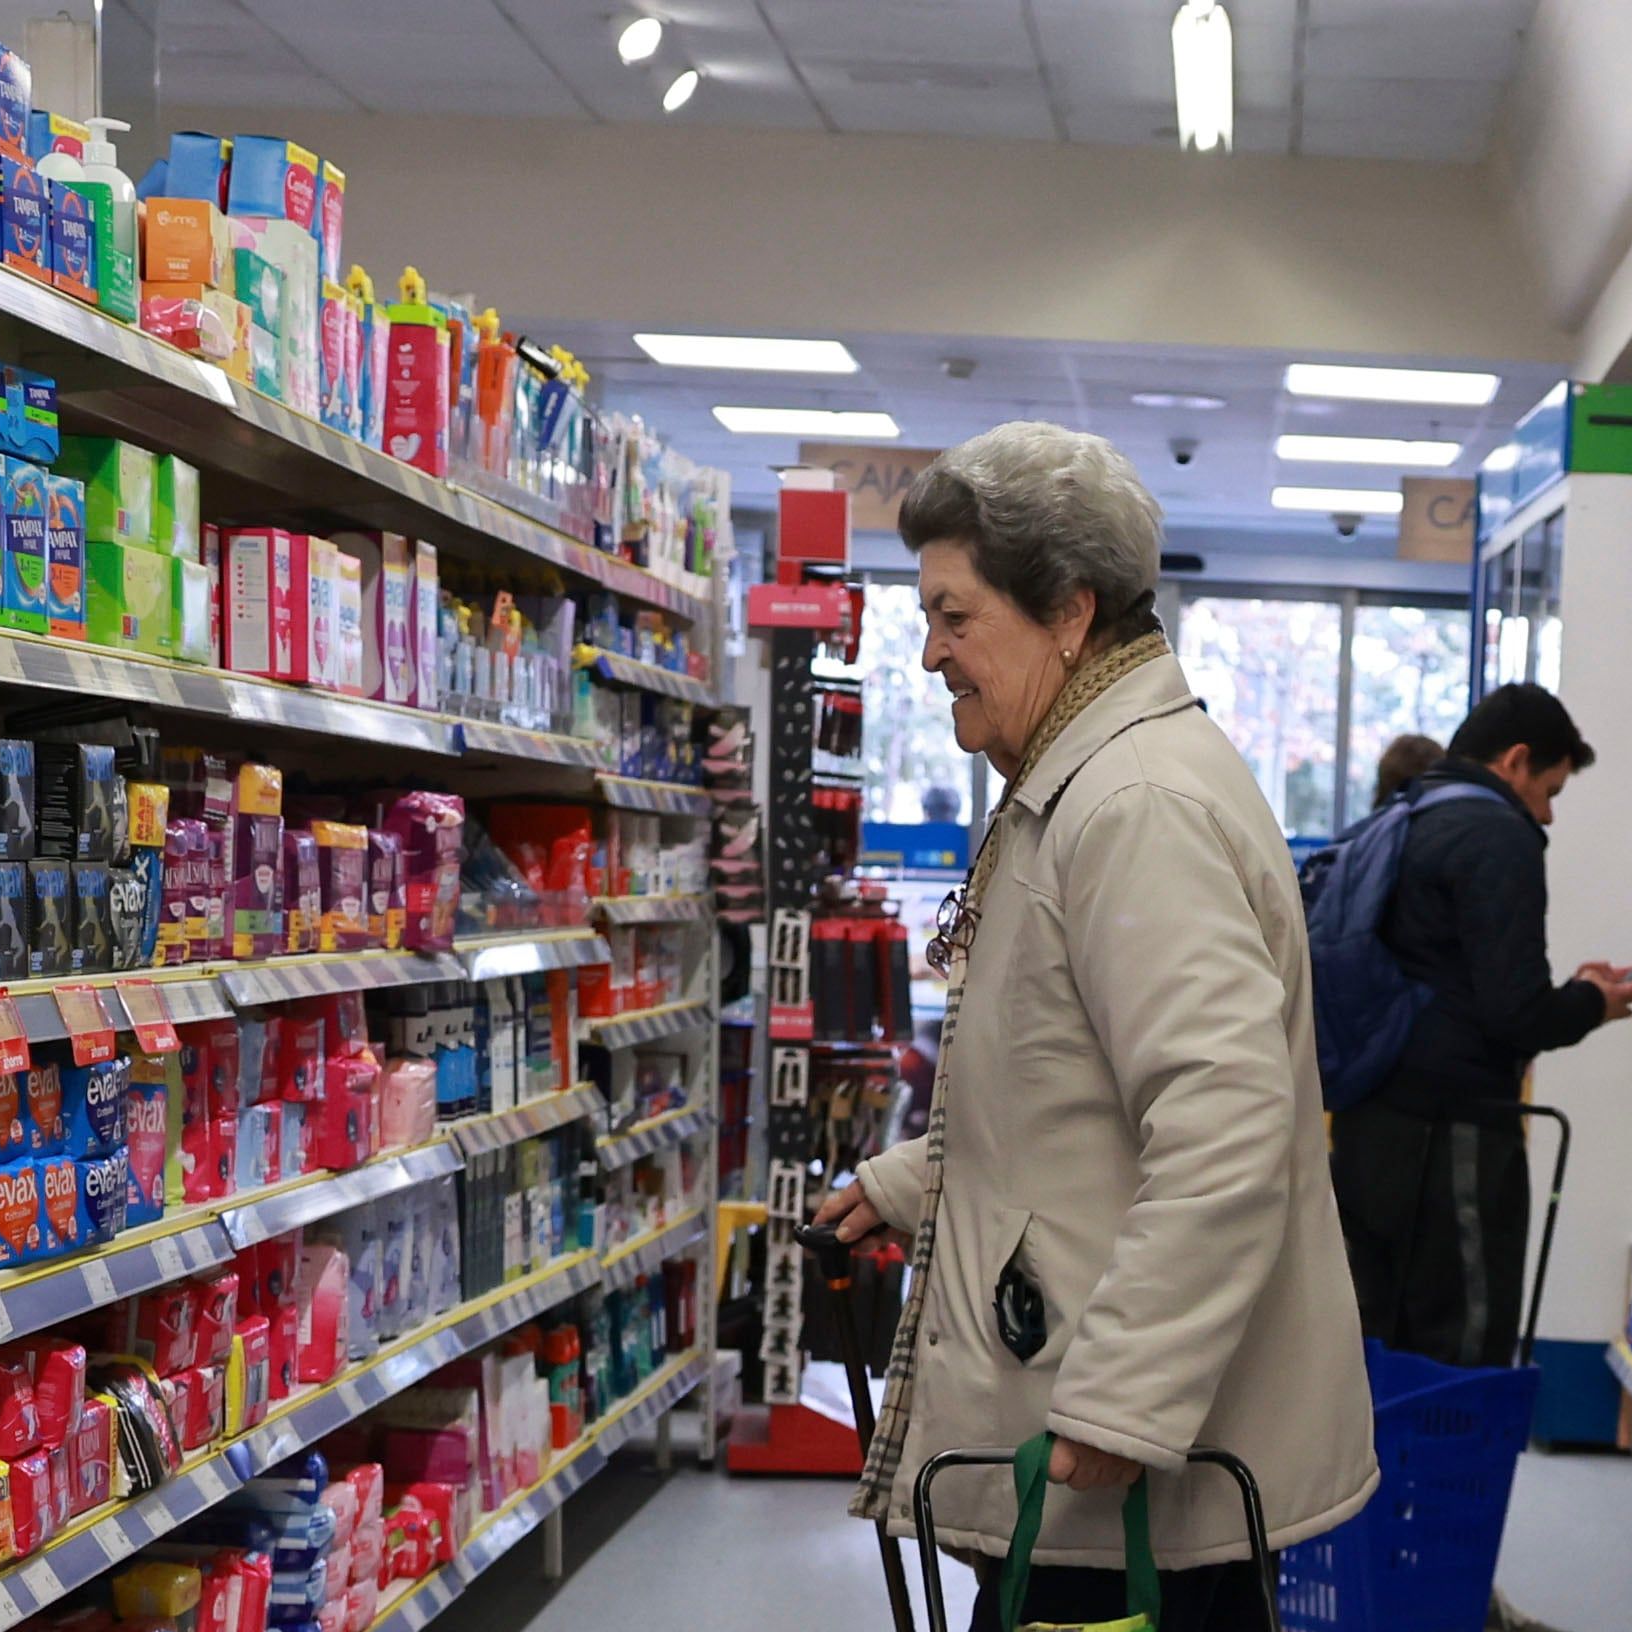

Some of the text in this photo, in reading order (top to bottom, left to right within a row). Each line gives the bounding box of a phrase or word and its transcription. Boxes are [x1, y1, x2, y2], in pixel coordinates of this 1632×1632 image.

[13, 196, 41, 219] TAMPAX
[11, 518, 43, 540] TAMPAX
[76, 869, 107, 898] evax
[109, 883, 146, 914] evax
[3, 1053, 25, 1071] ahorro
[27, 1062, 62, 1099] evax
[127, 1099, 165, 1133] evax
[44, 1160, 77, 1197] evax
